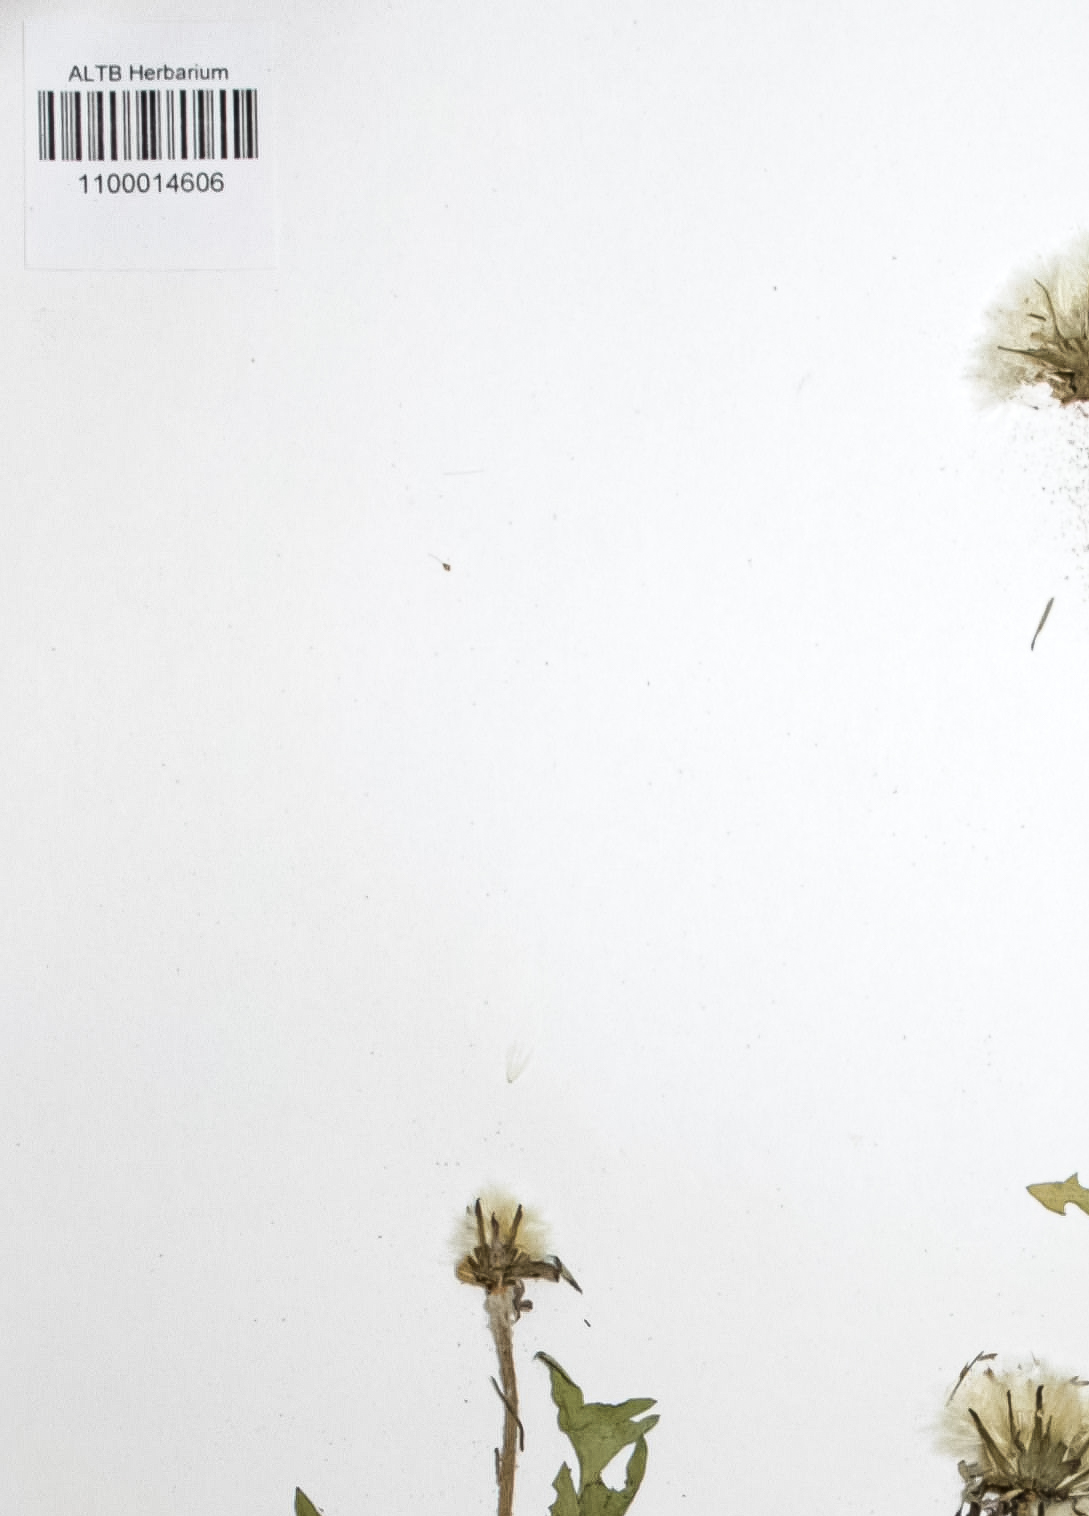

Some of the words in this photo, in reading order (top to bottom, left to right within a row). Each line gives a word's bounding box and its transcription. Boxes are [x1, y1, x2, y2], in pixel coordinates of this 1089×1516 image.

[68, 65, 122, 82] ALTB
[129, 64, 229, 81] Herbarium
[78, 172, 225, 194] 1100014606
